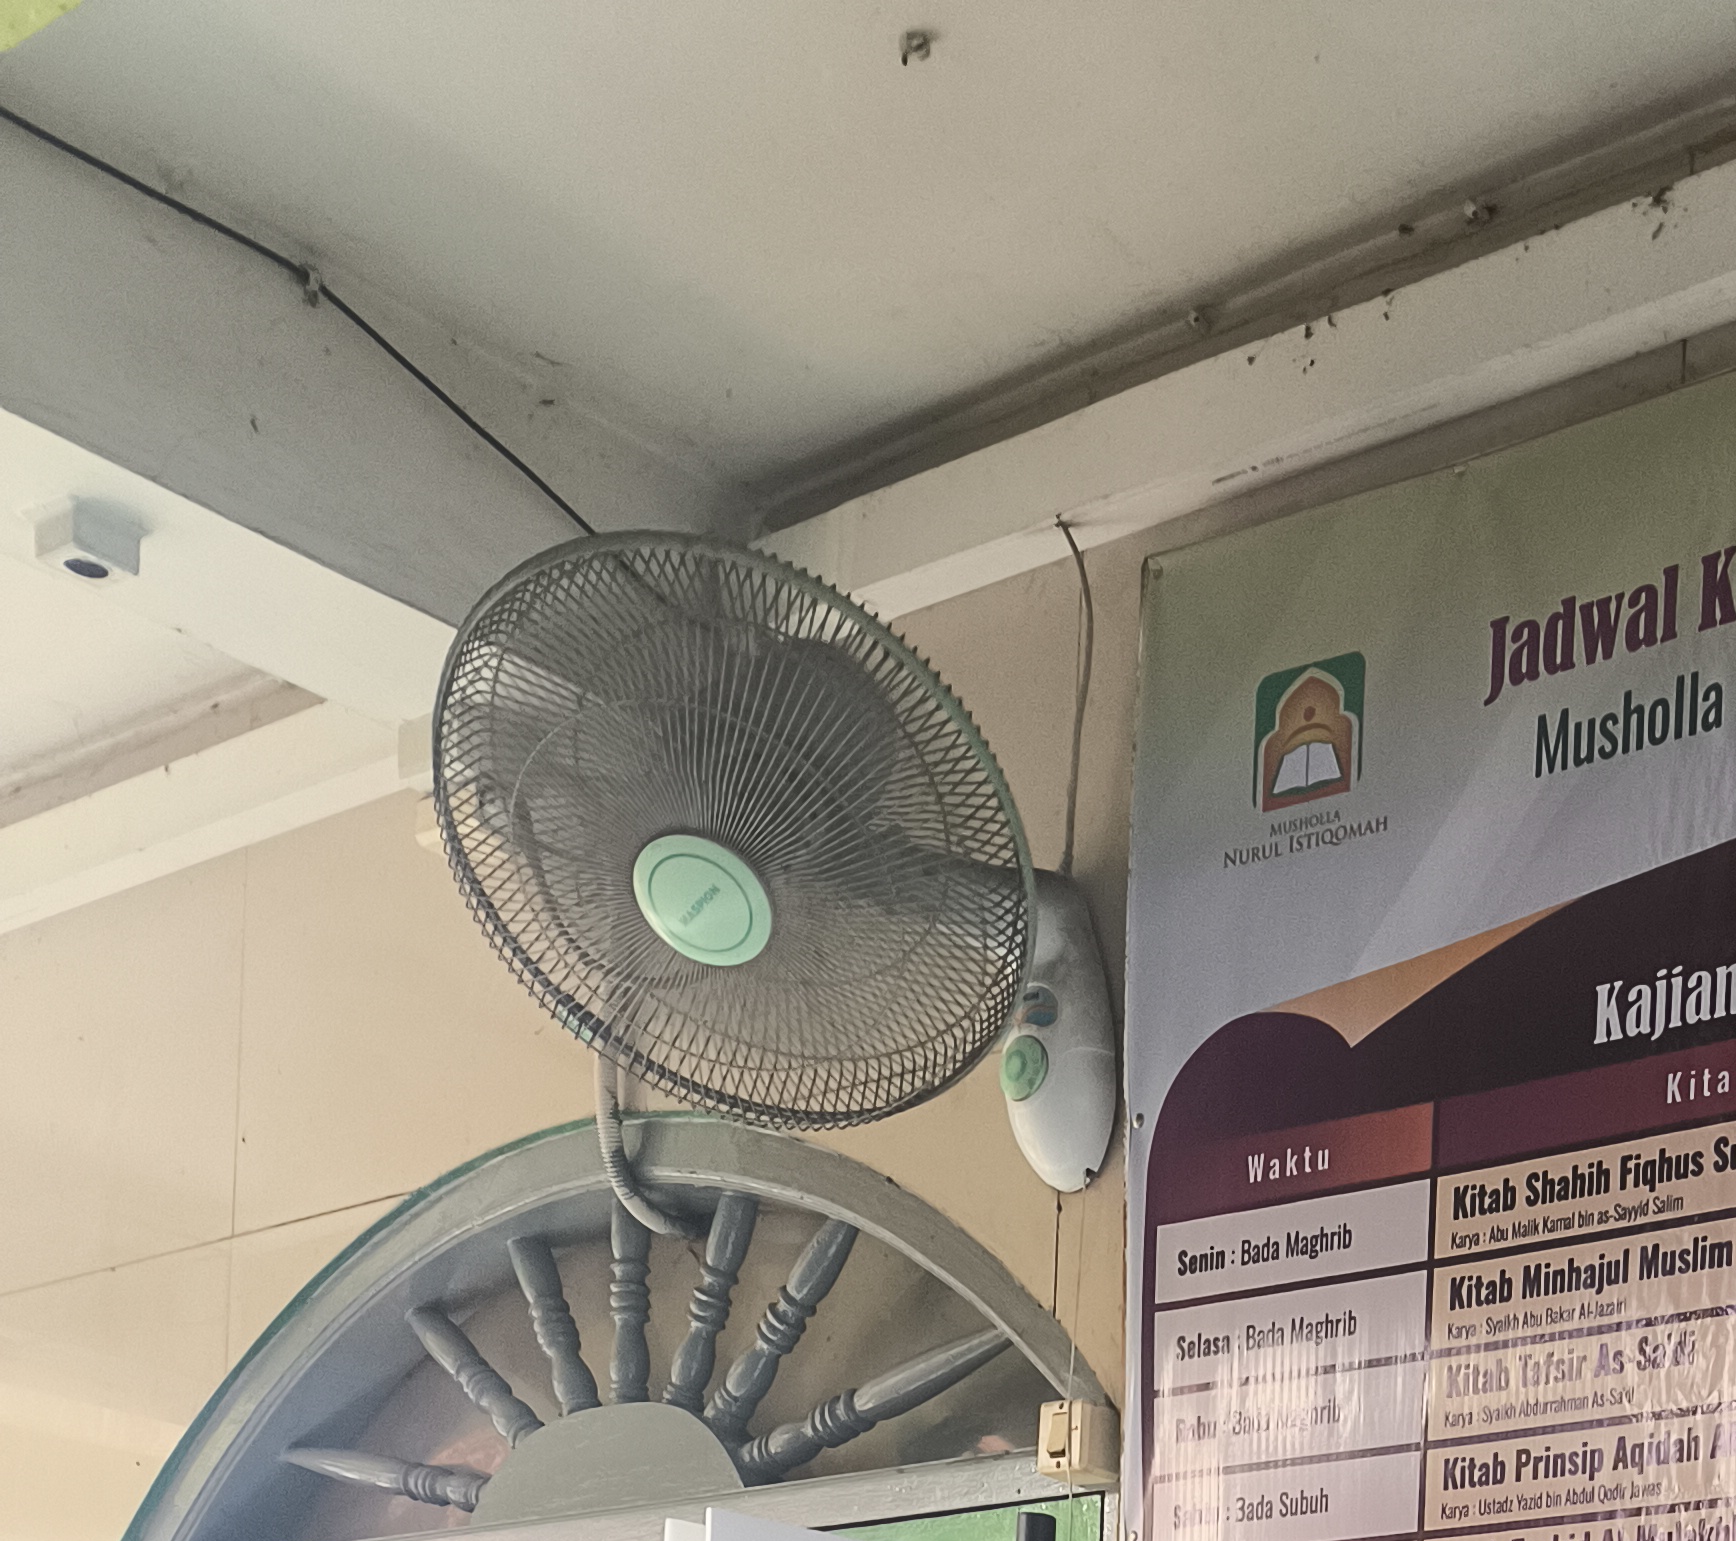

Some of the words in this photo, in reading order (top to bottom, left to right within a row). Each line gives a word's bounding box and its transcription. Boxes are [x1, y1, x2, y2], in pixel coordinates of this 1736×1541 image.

[1483, 563, 1680, 707] Jadwal
[1534, 670, 1723, 779] Musholla
[1223, 842, 1283, 869] NURUL
[1288, 815, 1388, 854] ISTIQOMAH
[1268, 809, 1342, 838] MUSHOLLA
[1247, 1146, 1329, 1184] Waktu
[1452, 1177, 1517, 1221] Kitab
[1525, 1159, 1611, 1208] Shahih
[1619, 1147, 1705, 1193] Fiqhus
[1450, 1231, 1480, 1251] Karya
[1488, 1224, 1509, 1245] Abu
[1511, 1215, 1545, 1241] Malik
[1543, 1211, 1576, 1235] Kamal
[1577, 1209, 1595, 1229] bin
[1596, 1198, 1650, 1226] as-Sayyid
[1651, 1194, 1684, 1216] Salim
